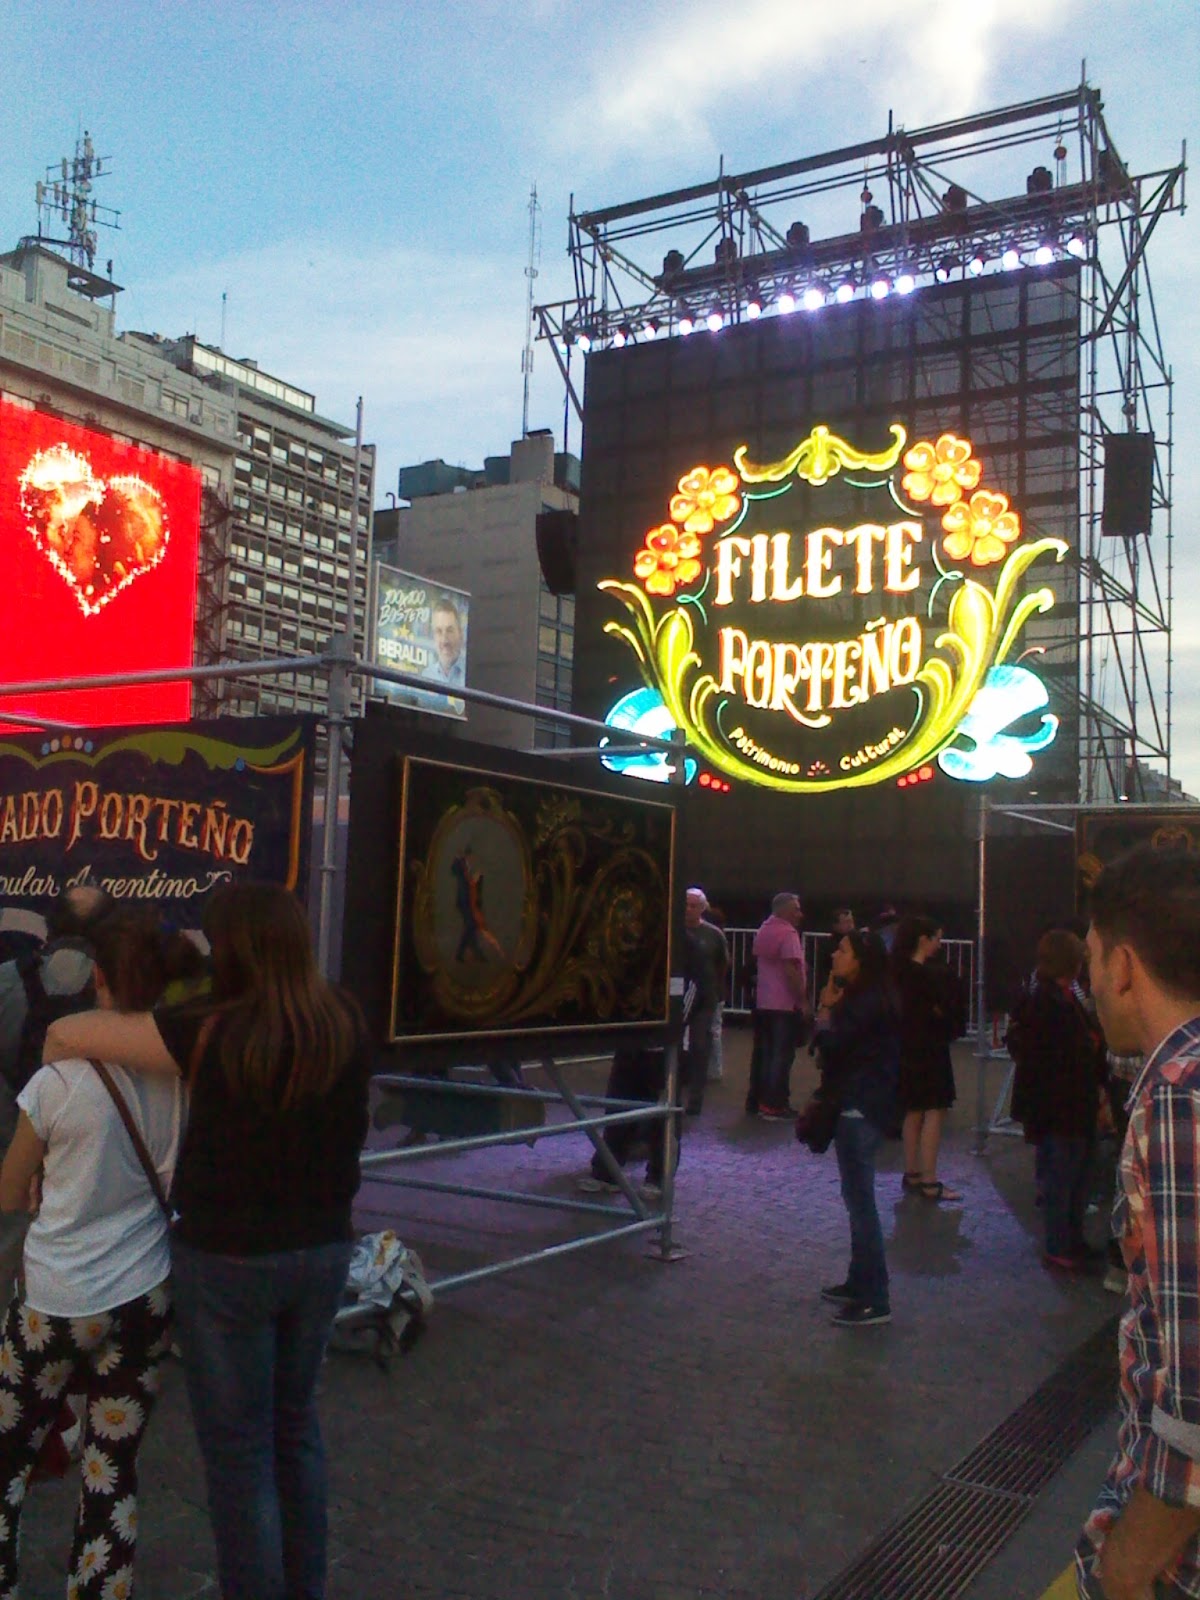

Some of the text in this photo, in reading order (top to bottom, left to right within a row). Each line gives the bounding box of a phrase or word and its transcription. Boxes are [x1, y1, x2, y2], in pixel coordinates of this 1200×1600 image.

[713, 522, 923, 605] FILETE
[378, 638, 427, 666] BERALDI
[718, 616, 923, 728] PORTEÑO
[728, 727, 906, 775] Patrimonio Cultural
[0, 781, 255, 865] ADO PORTEÑO
[66, 864, 205, 898] Aentino
